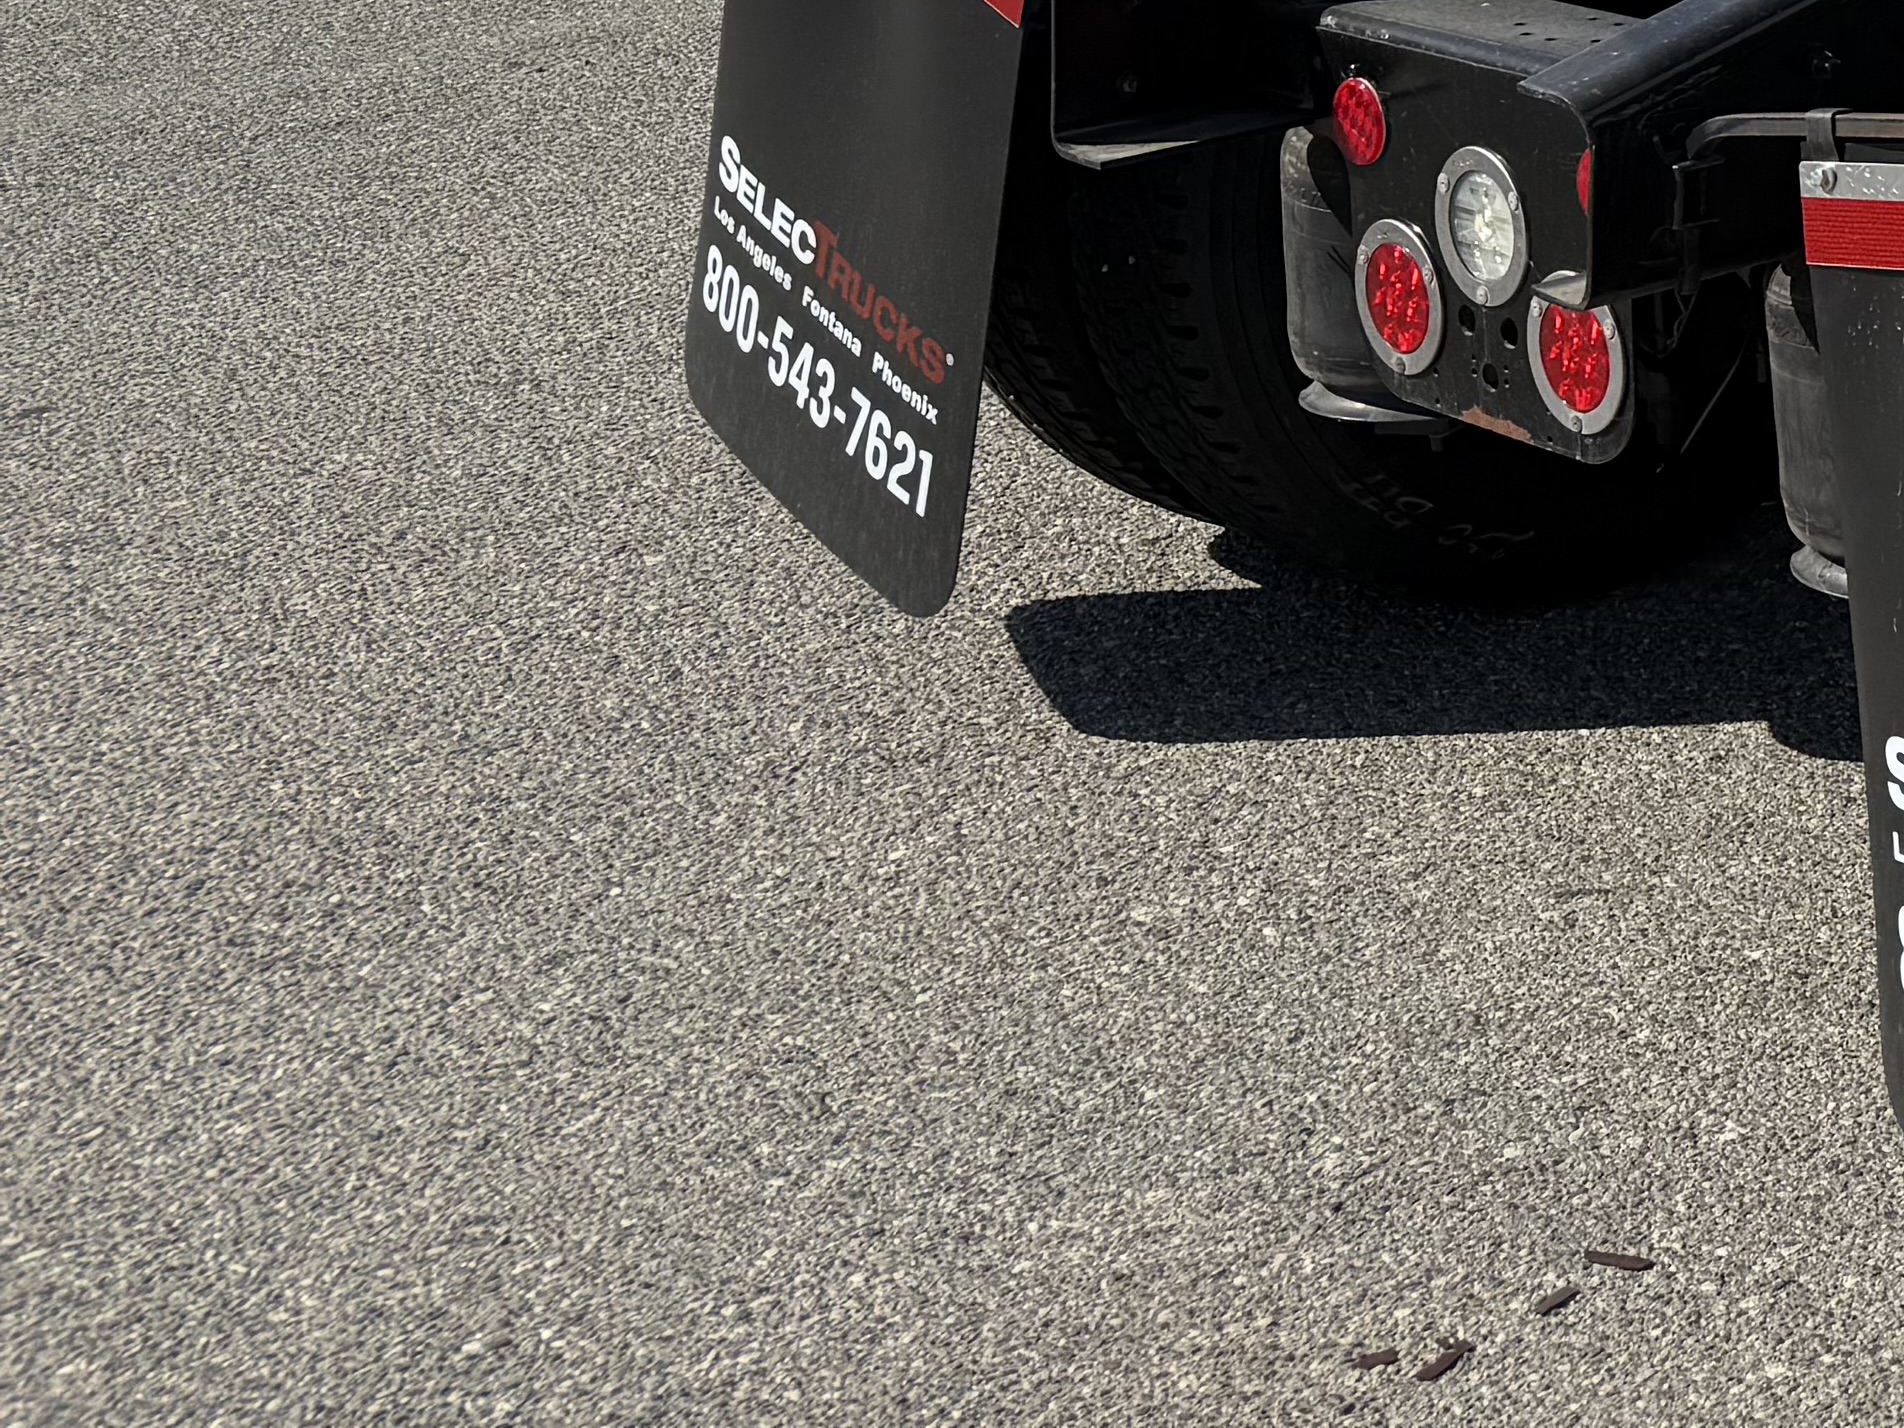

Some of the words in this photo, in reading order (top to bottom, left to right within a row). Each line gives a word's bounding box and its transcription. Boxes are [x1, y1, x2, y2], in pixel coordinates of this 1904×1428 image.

[702, 244, 933, 518] 800-543-7621
[713, 195, 735, 234] Los
[736, 224, 792, 291] Angeles
[801, 285, 862, 357] Fontana
[871, 351, 939, 425] Phoenix
